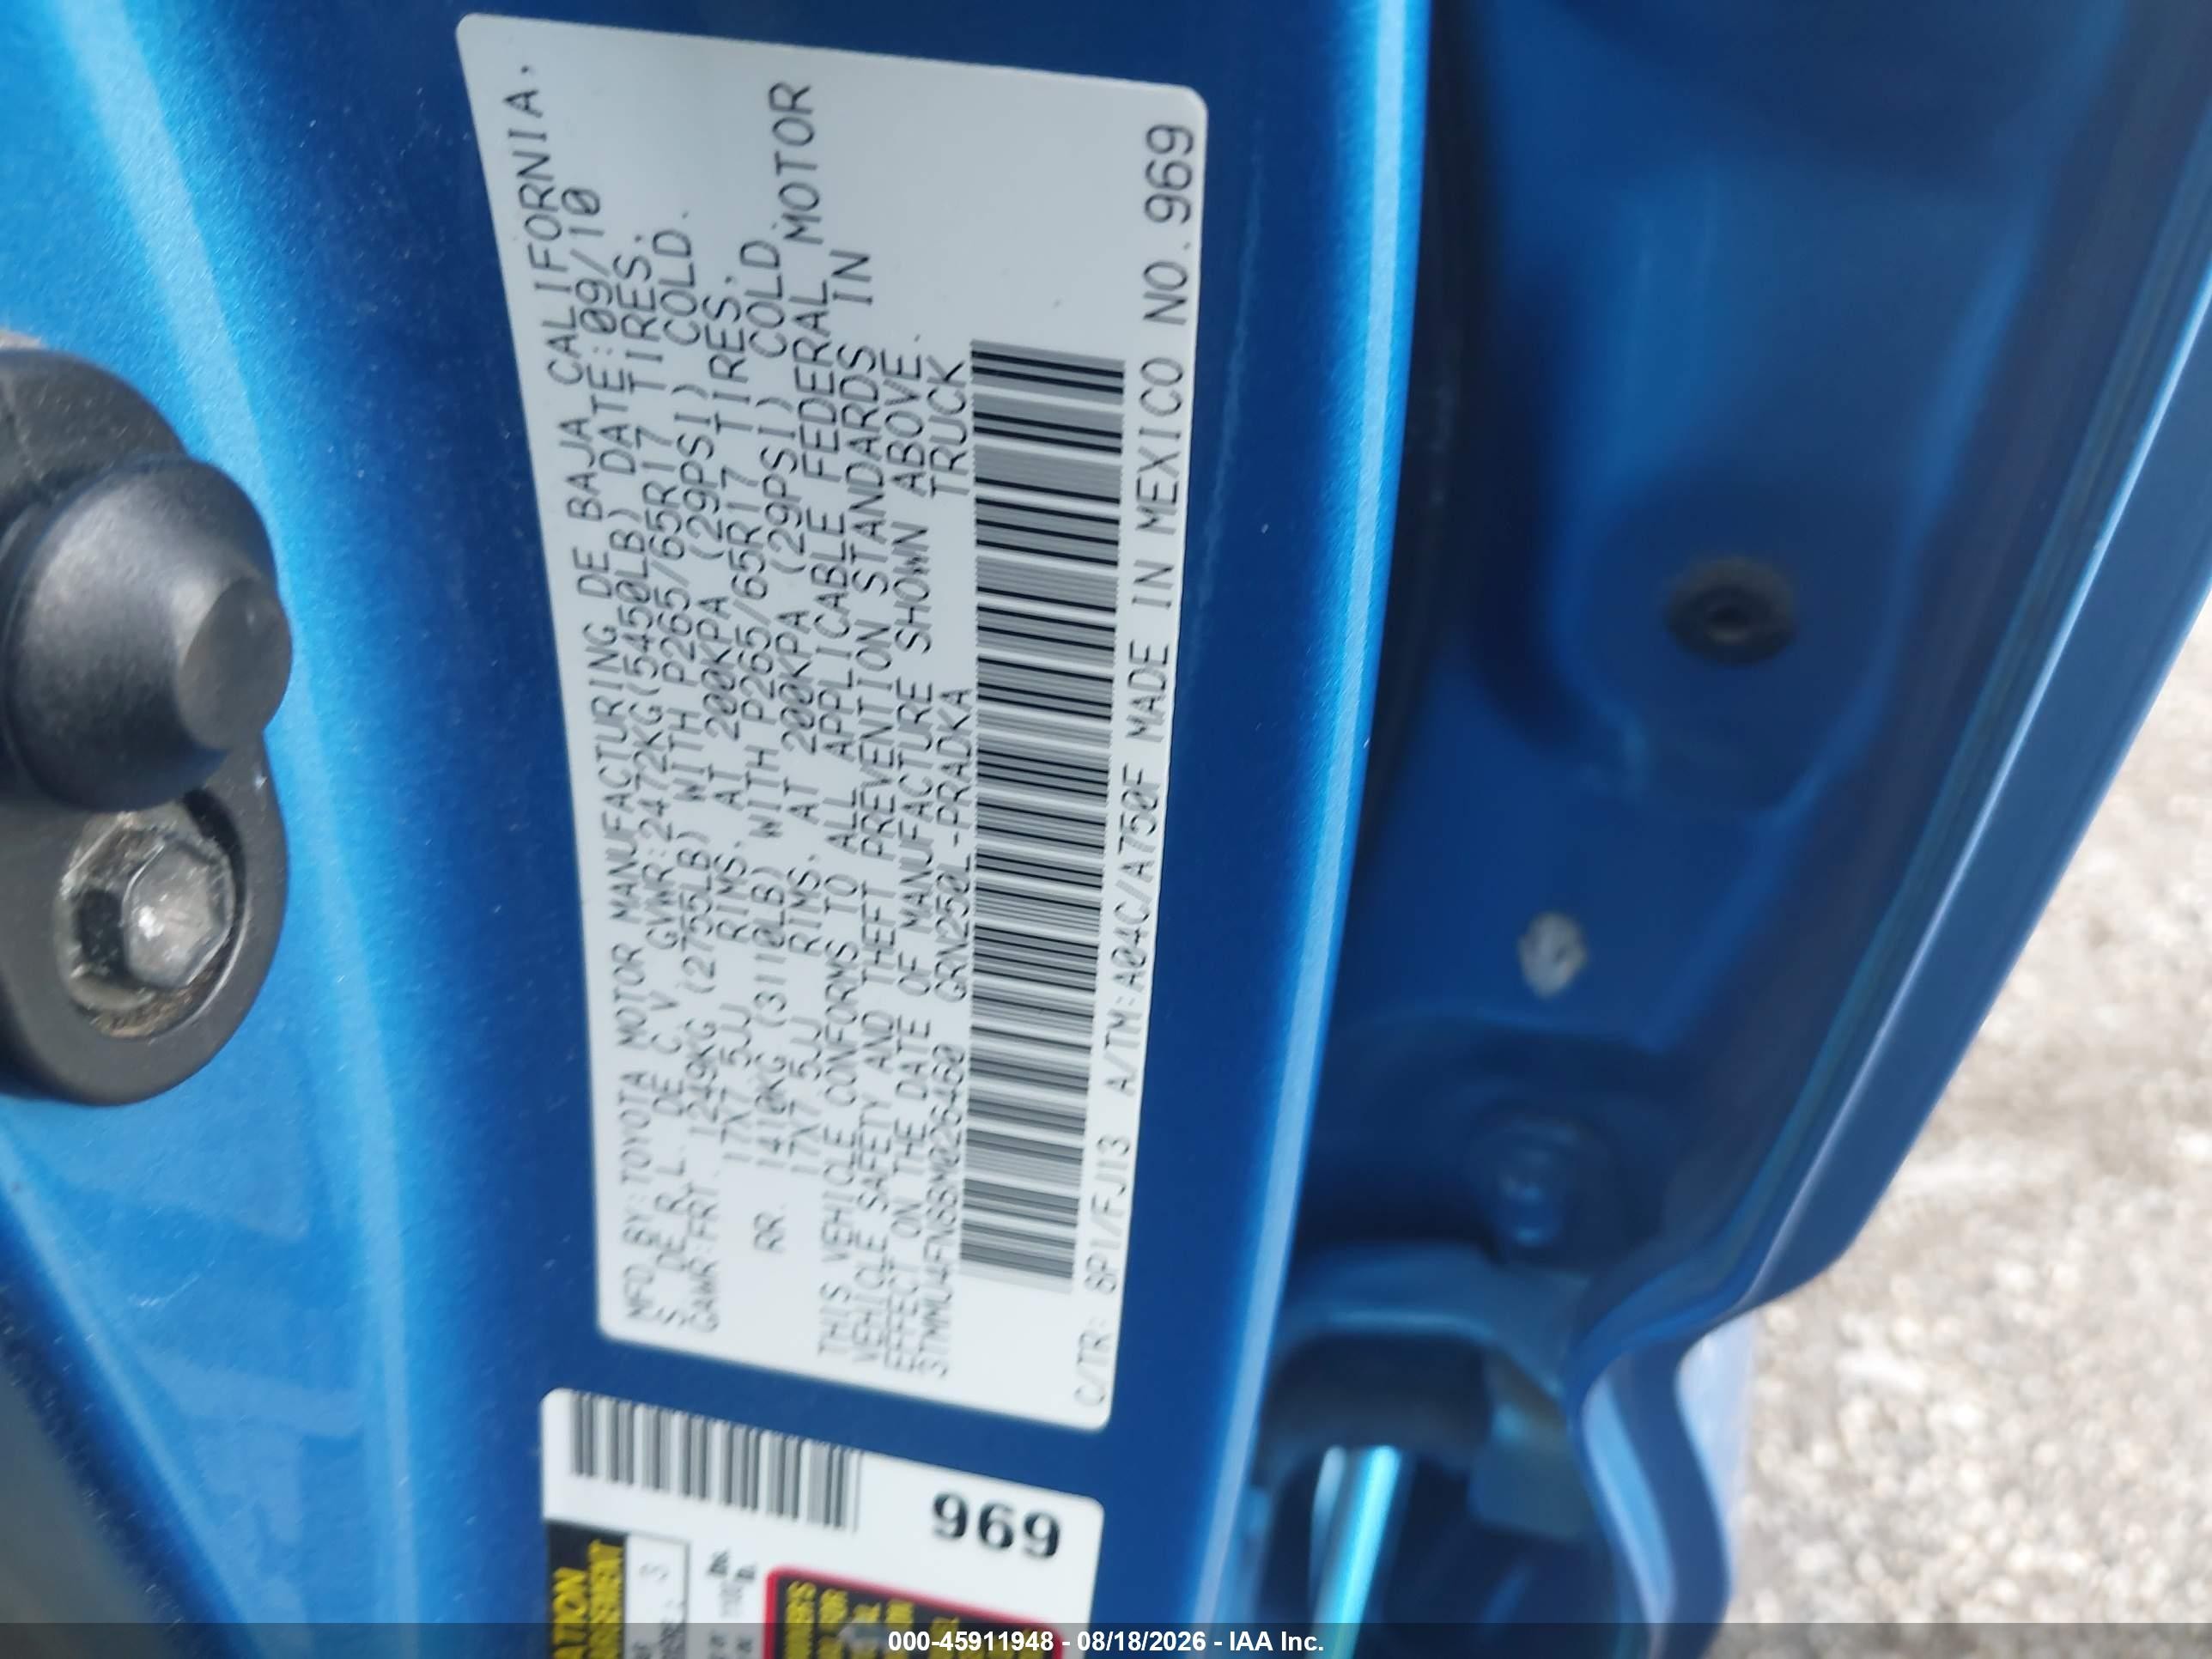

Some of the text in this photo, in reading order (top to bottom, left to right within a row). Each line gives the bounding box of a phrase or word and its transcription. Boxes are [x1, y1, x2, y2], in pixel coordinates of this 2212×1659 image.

[560, 185, 637, 476] DATE:09/10
[651, 209, 702, 346] COLD.
[738, 220, 790, 357] COLD.
[557, 416, 603, 521] BAJA
[670, 381, 726, 561] (29PSI)
[754, 394, 806, 574] (29PSI)
[926, 354, 969, 499] TRUCK
[1132, 355, 1185, 535] MEXICO
[572, 544, 612, 599] DE
[634, 424, 698, 686] P265/65R17
[719, 463, 777, 724] P265/65R17
[1130, 559, 1175, 611] IN
[695, 595, 739, 741] 200KPA
[767, 79, 859, 1355] THIS VEHICLE CONFORMS TO ALL APPLICABLE FEDERAL MOTOR
[774, 609, 817, 755] 200KPA
[1123, 637, 1170, 743] MADE
[581, 621, 642, 924] MANUFACTURING
[664, 706, 708, 802] WITH
[706, 762, 744, 811] AT
[740, 743, 784, 838] WITH
[781, 775, 820, 825] AT
[829, 248, 897, 1363] VEHICLE SAFETY AND THEFT PREVENTION STANDARDS IN
[676, 830, 716, 994] (2755LB)
[878, 332, 934, 1372] EFFECT ON THE DATE OF MANUFACTURE SHOWN ABOVE.
[611, 942, 648, 1049] MOTOR
[749, 864, 788, 1026] (3110LB)
[650, 1076, 685, 1117] DE
[933, 1492, 1061, 1559] 969
